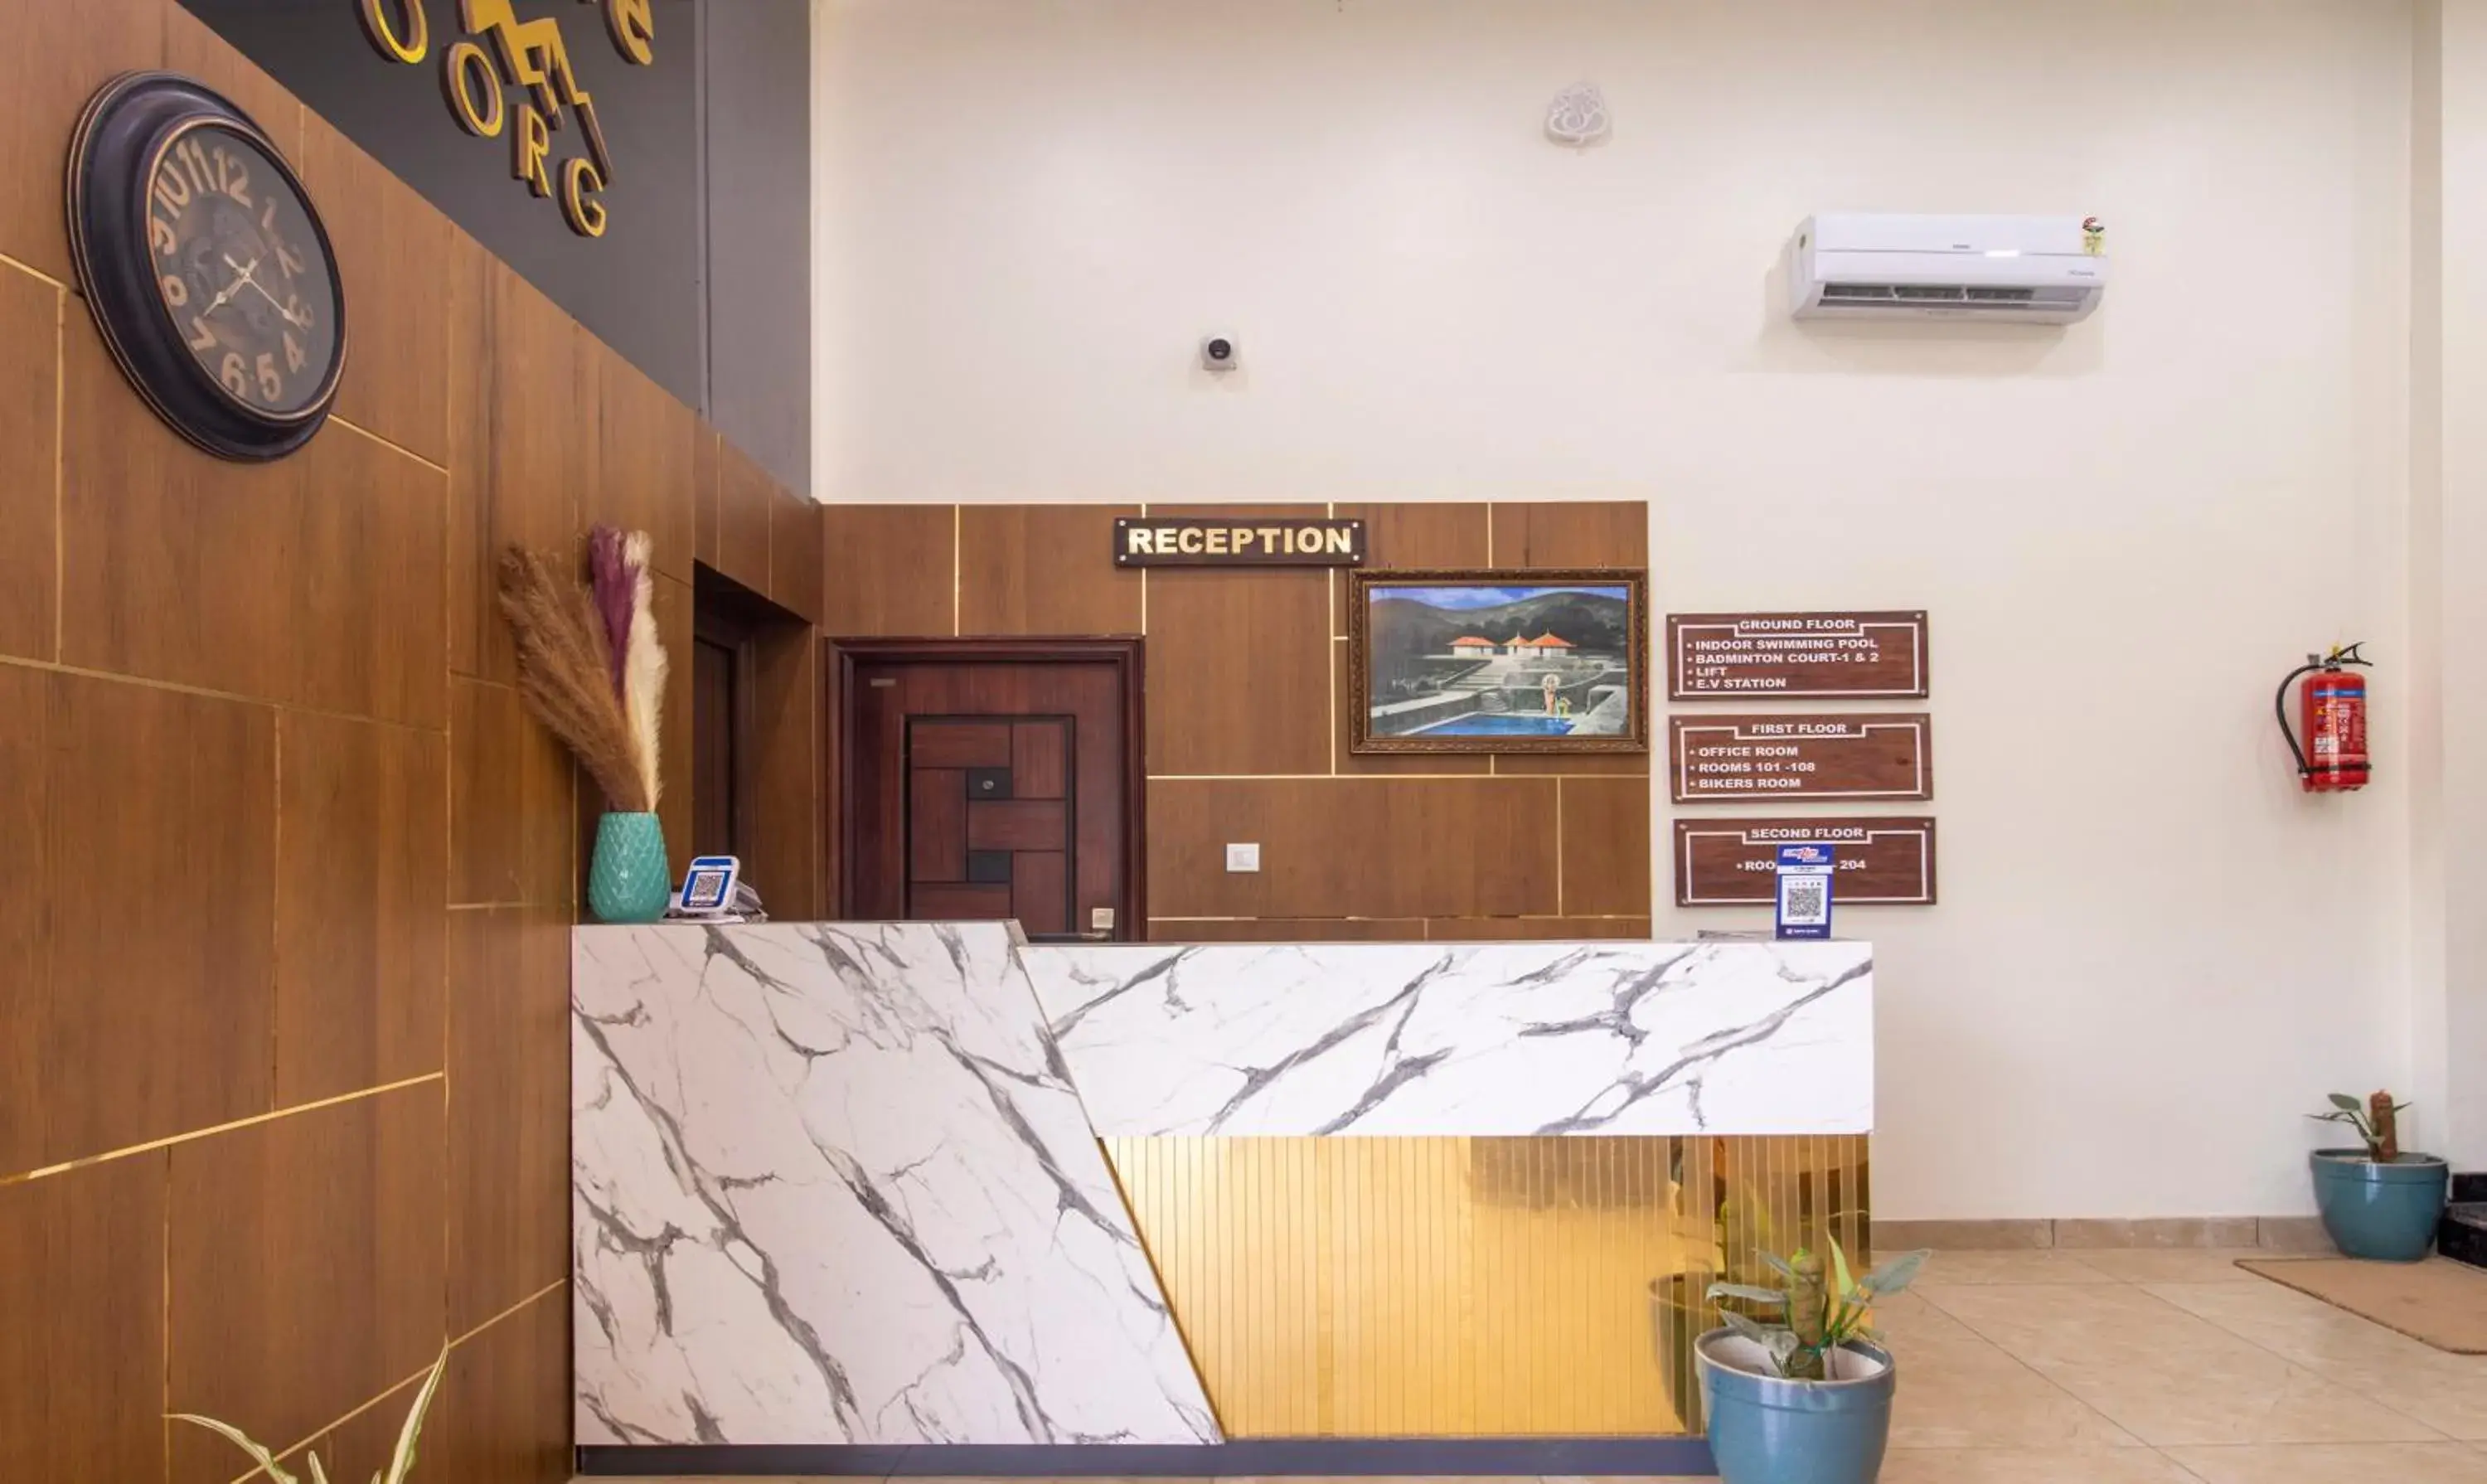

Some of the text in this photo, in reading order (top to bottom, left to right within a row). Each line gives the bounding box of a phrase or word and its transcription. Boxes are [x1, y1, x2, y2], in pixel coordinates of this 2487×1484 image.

[177, 138, 217, 194] 11
[212, 144, 252, 208] 12
[155, 159, 190, 220] 10
[191, 316, 216, 351] 7
[221, 352, 246, 398] 6
[256, 352, 282, 402] 5
[1128, 526, 1352, 554] RECEPTION
[1739, 619, 1855, 630] GROUND FLOOR
[1695, 638, 1878, 651] INDOOR SWIMMING POOL
[1695, 652, 1879, 664] BADMINTON COURT-1 & 2
[1696, 667, 1727, 677] LIFT
[1697, 678, 1786, 689] E.V STATION
[1752, 724, 1847, 734] FIRST FLOOR
[1699, 747, 1798, 757] OFFICE ROOM
[1699, 763, 1752, 773] ROOMS
[1756, 763, 1780, 772] 101
[1699, 778, 1801, 788] BIKERS ROOM
[1751, 828, 1864, 838] SECOND FLOOR
[1745, 859, 1866, 871] ROO 204
